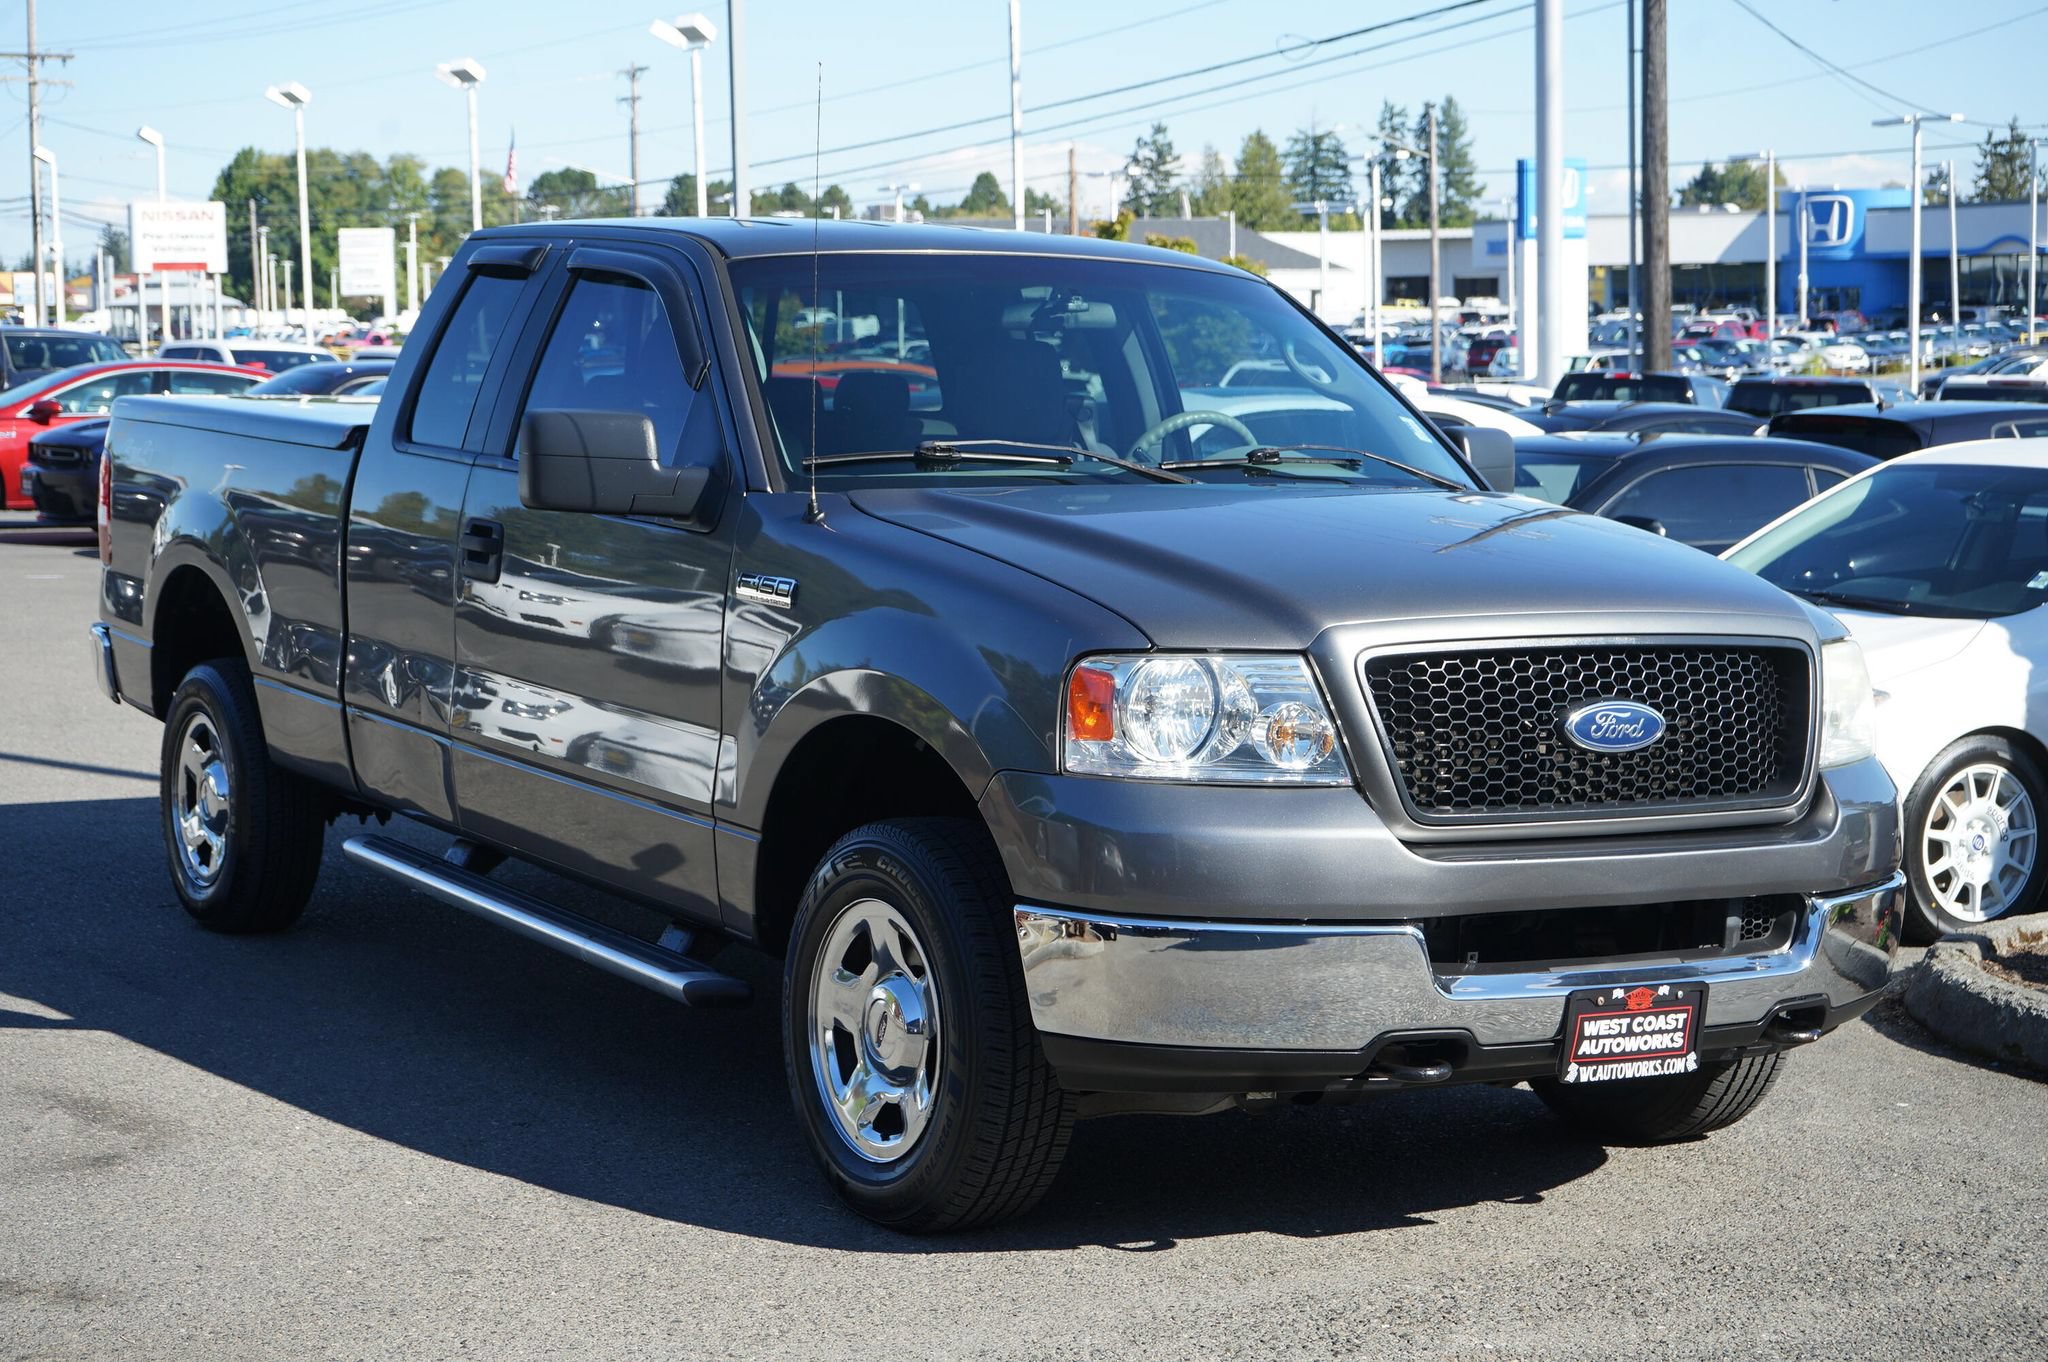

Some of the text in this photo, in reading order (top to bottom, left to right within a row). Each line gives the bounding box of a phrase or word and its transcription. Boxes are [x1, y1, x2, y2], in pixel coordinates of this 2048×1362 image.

[142, 211, 215, 221] NISSAN
[1590, 711, 1645, 739] Ford
[1583, 1013, 1688, 1037] WEST COAST
[1578, 1032, 1684, 1056] AUTOWORKS
[1578, 1057, 1687, 1083] WCAUTOWORKS.COM
